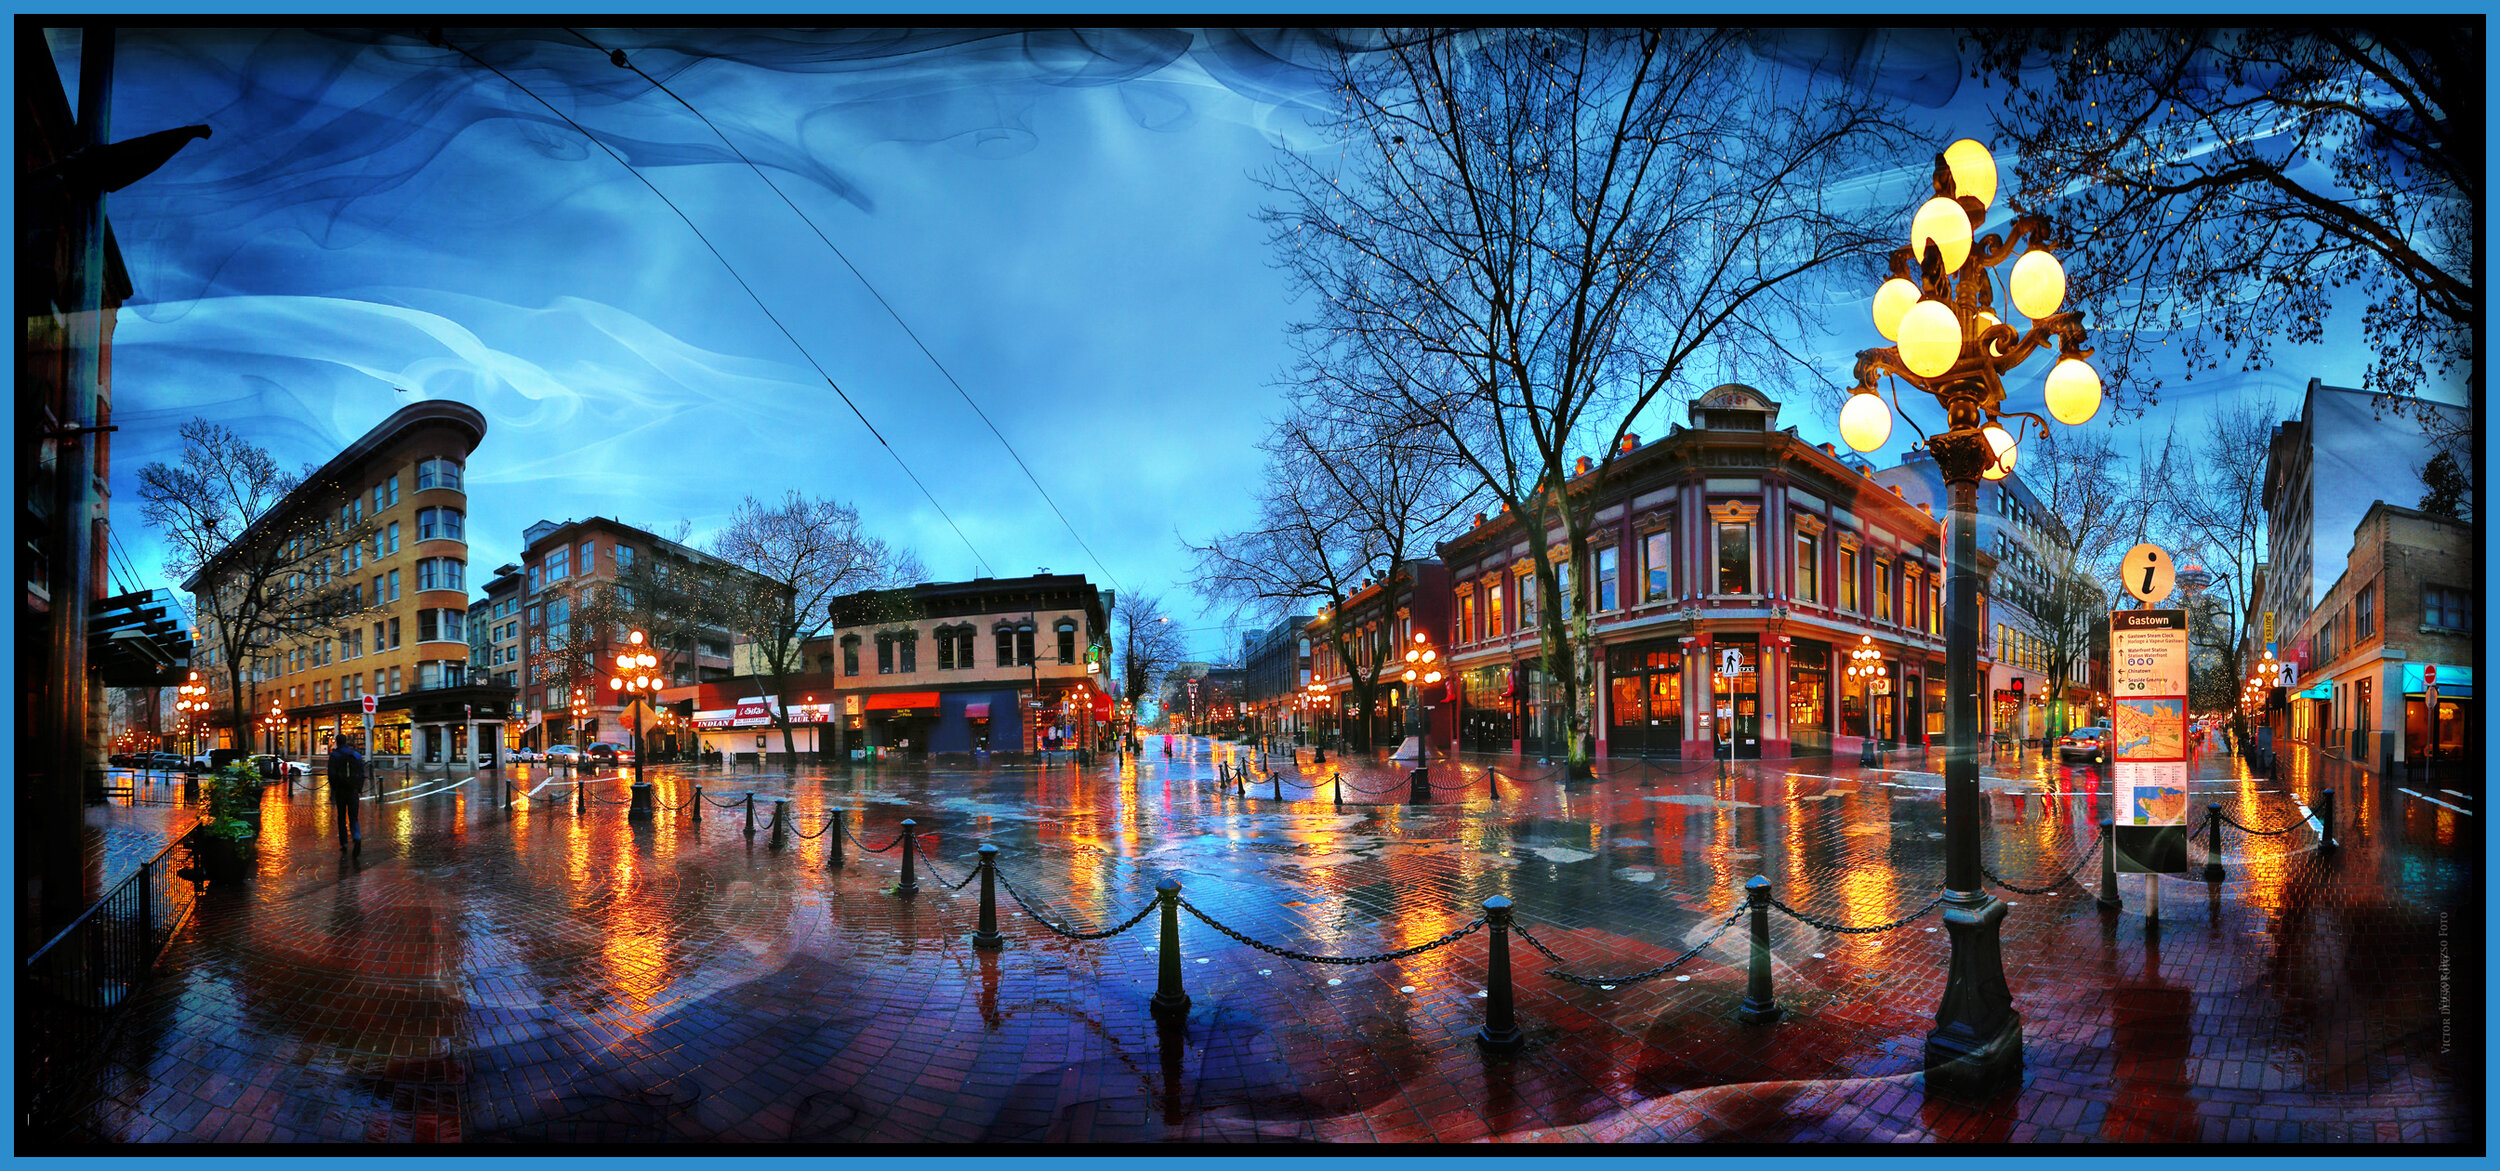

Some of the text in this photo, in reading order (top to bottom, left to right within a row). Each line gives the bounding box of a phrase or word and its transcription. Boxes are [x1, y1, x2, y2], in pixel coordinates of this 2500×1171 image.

[2128, 616, 2169, 625] Gastown
[744, 706, 765, 715] Sitar
[697, 719, 729, 728] INDIAN
